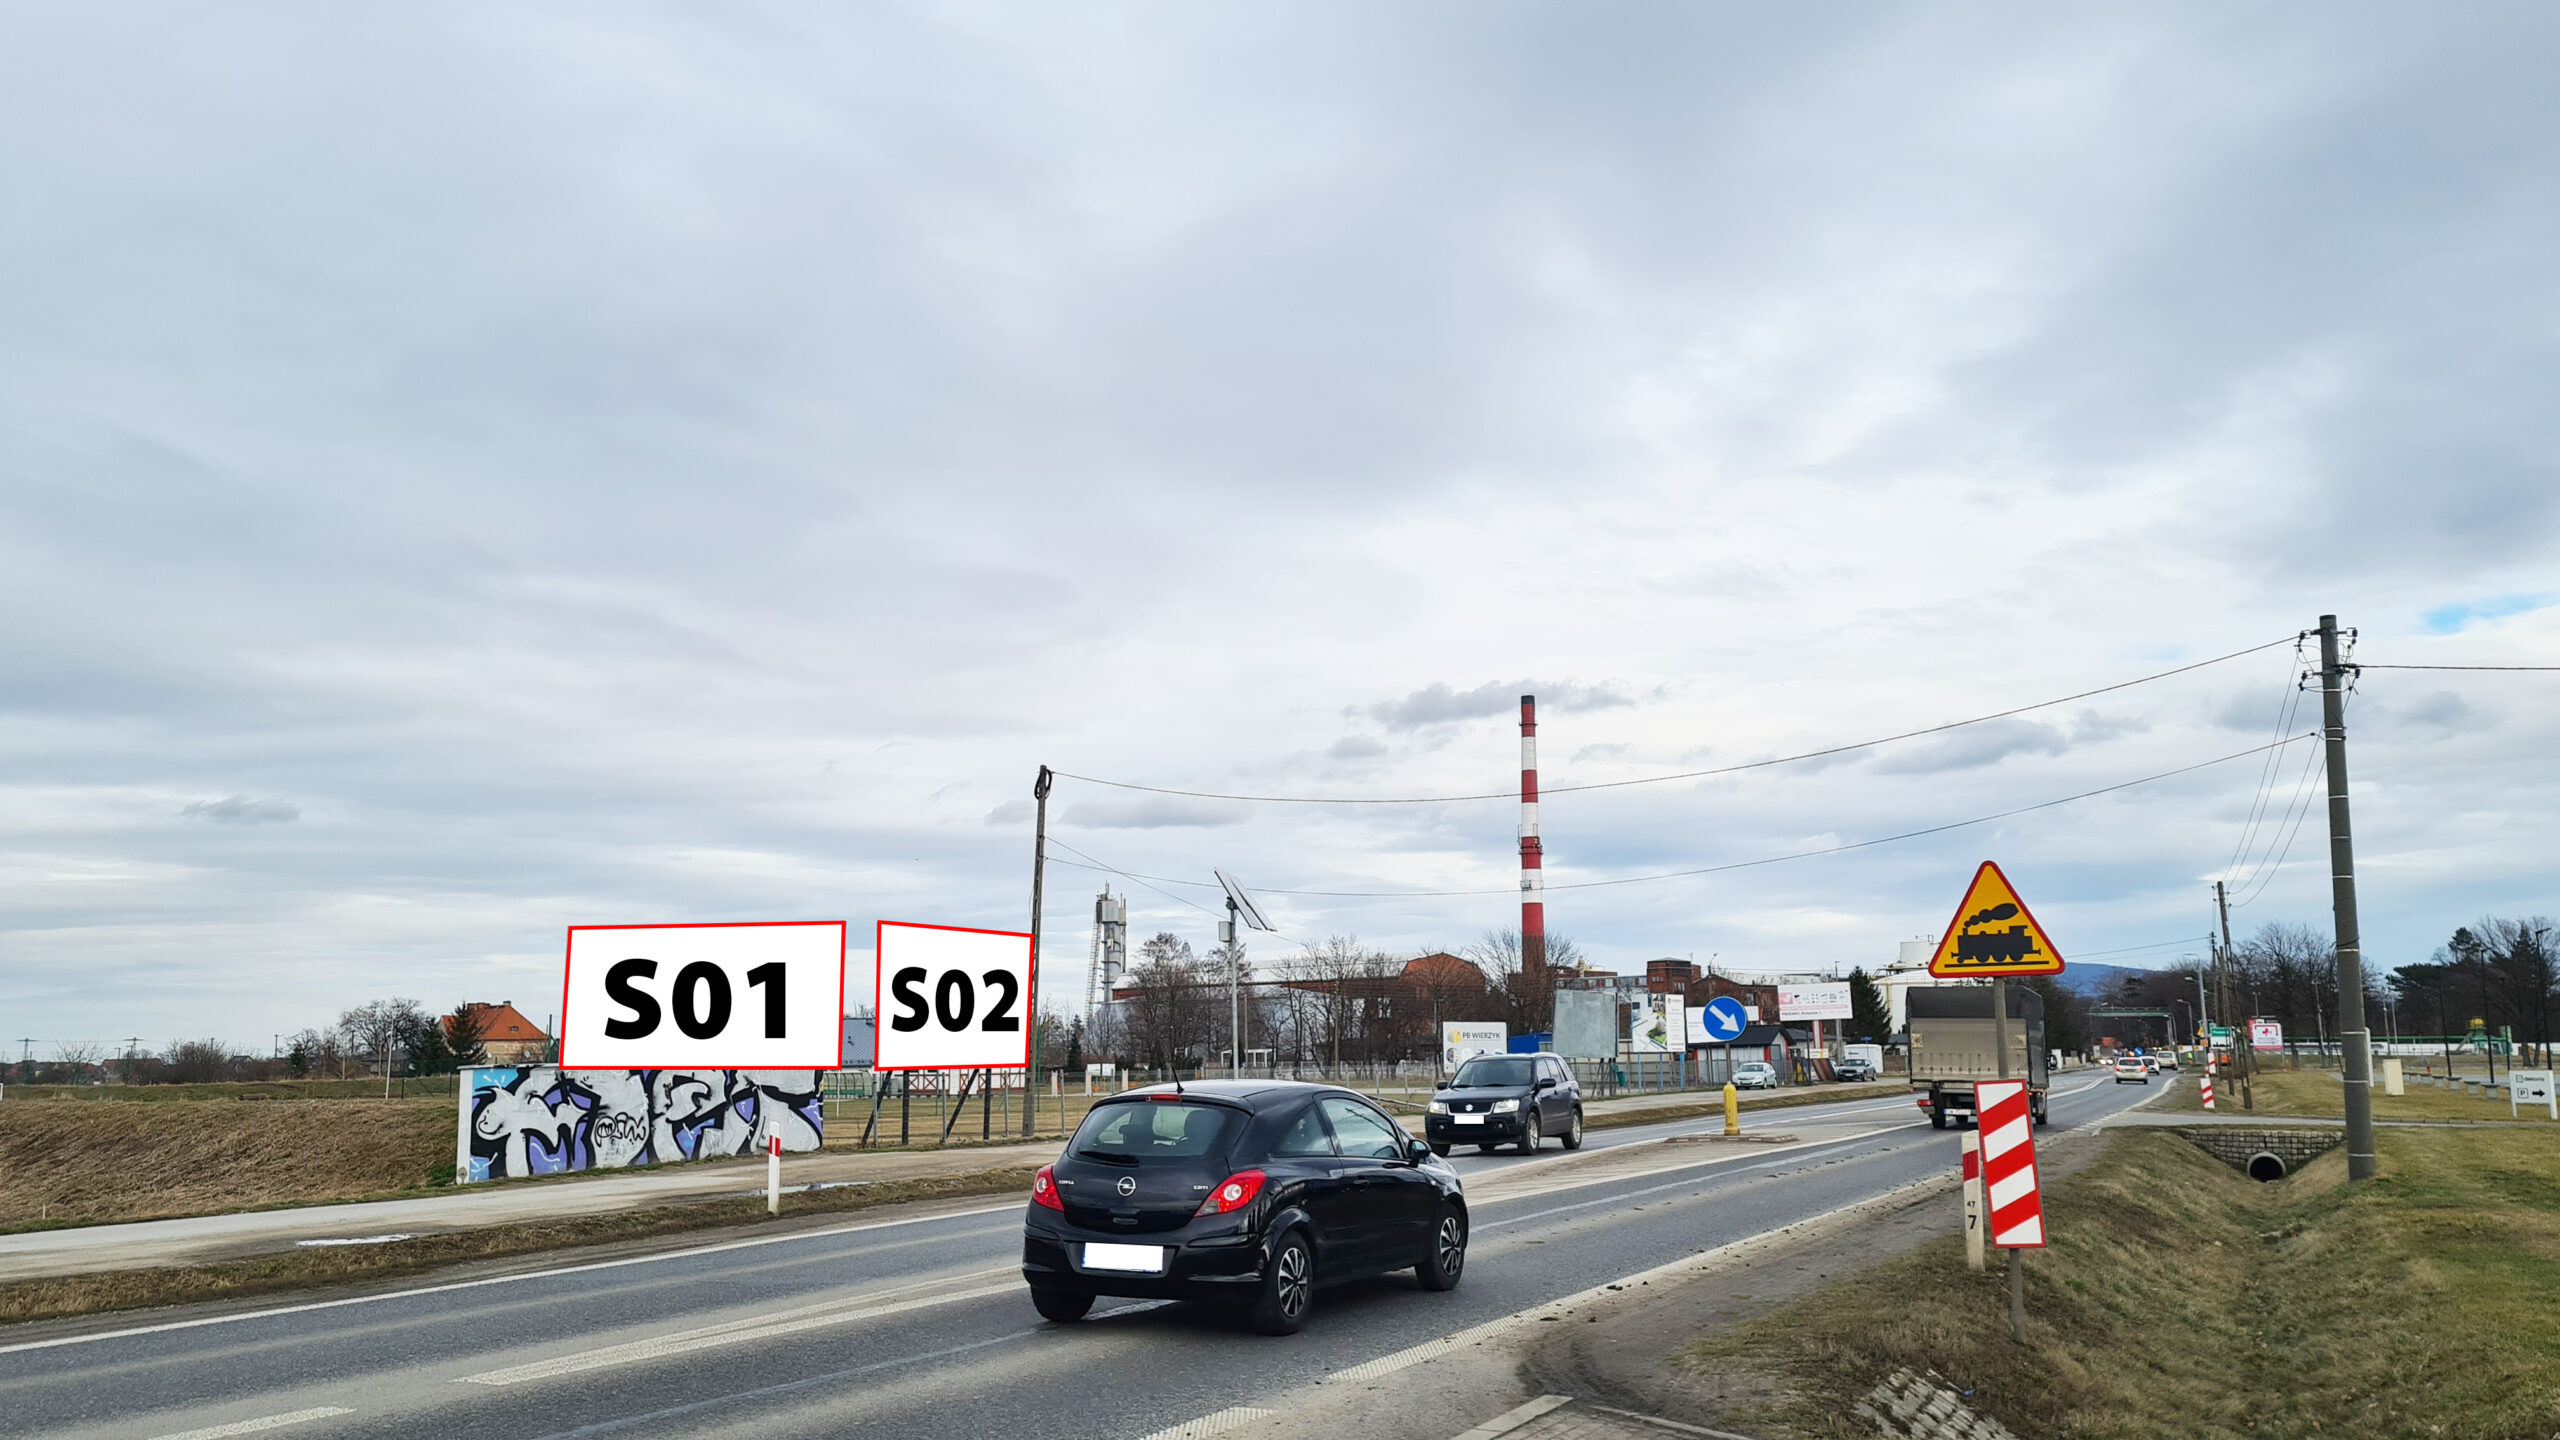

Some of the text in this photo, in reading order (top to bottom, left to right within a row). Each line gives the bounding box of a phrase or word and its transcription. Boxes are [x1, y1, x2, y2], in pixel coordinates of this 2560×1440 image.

[1462, 1031, 1471, 1039] PB
[1966, 1200, 1976, 1208] 47
[1967, 1214, 1977, 1230] 7
